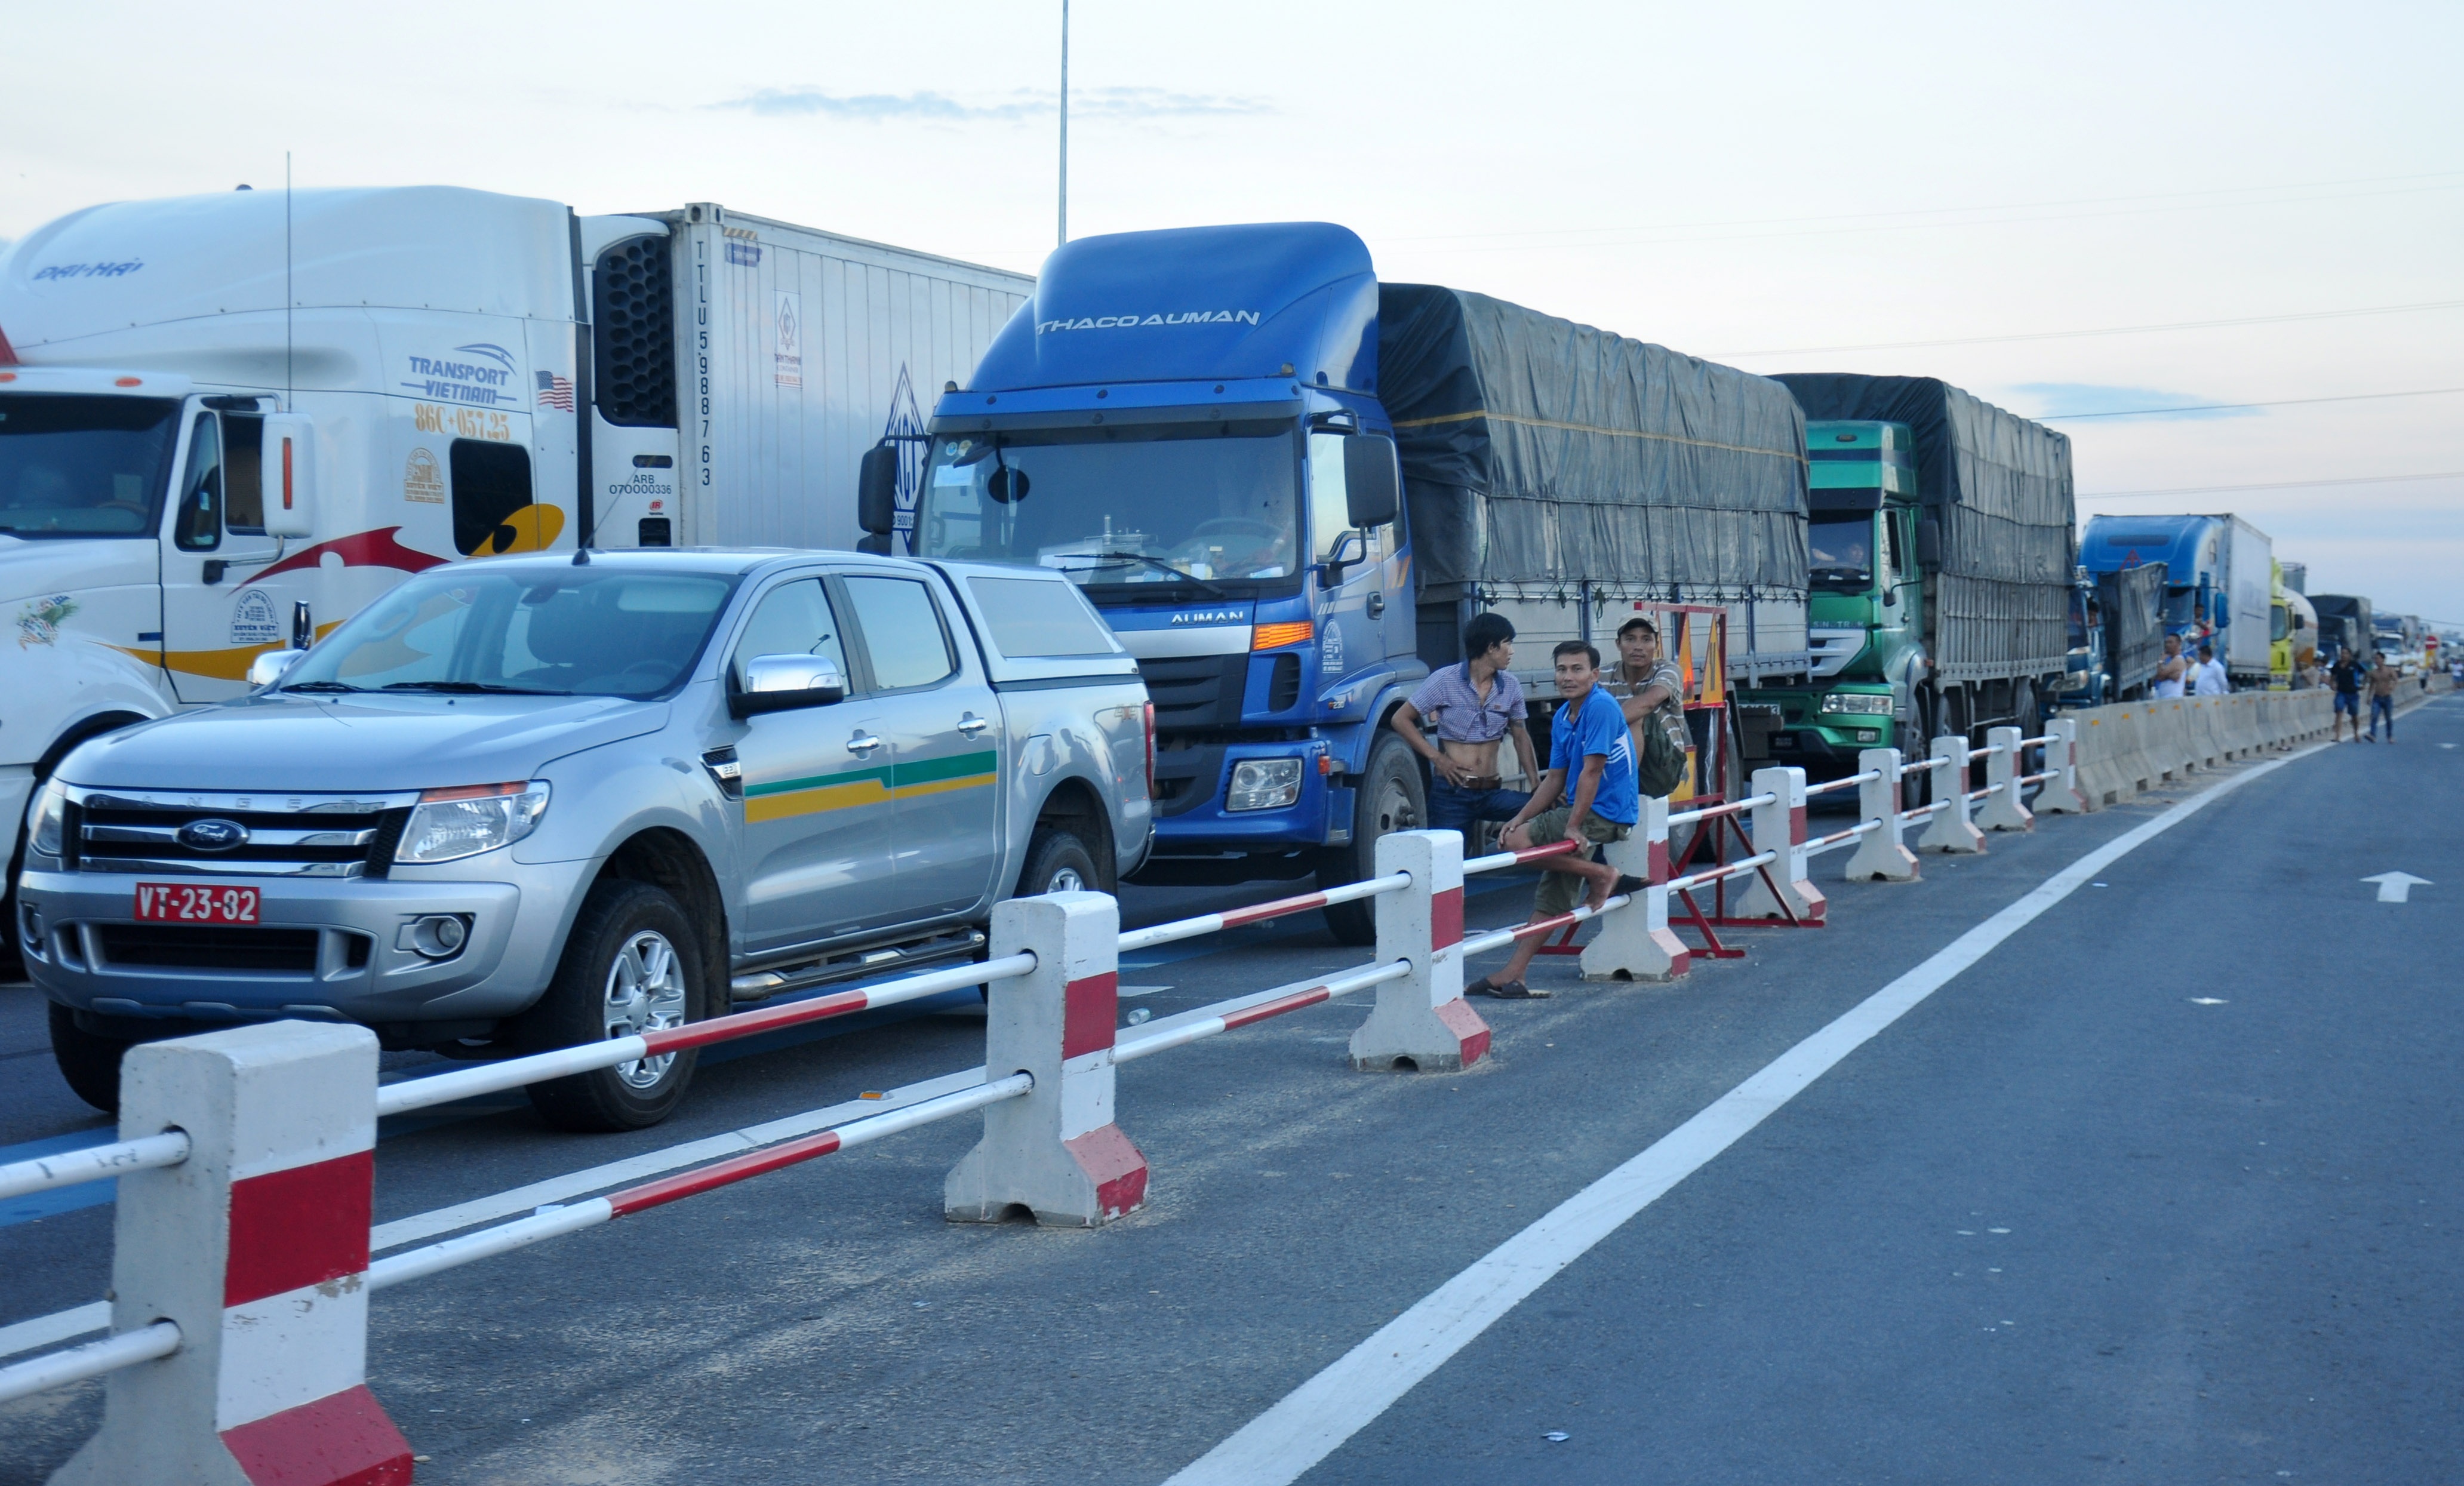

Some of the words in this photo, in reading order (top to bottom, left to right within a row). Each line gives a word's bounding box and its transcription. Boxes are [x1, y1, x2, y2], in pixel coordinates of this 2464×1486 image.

[1036, 315, 1135, 336] THACO
[1139, 310, 1260, 326] AUMAN
[409, 356, 509, 386] TRANSPORT
[425, 379, 497, 404] VIETNAM
[633, 475, 655, 484] ARB
[1170, 611, 1244, 626] AUMAN
[193, 823, 229, 842] Ford
[139, 887, 256, 921] VT-23-82
